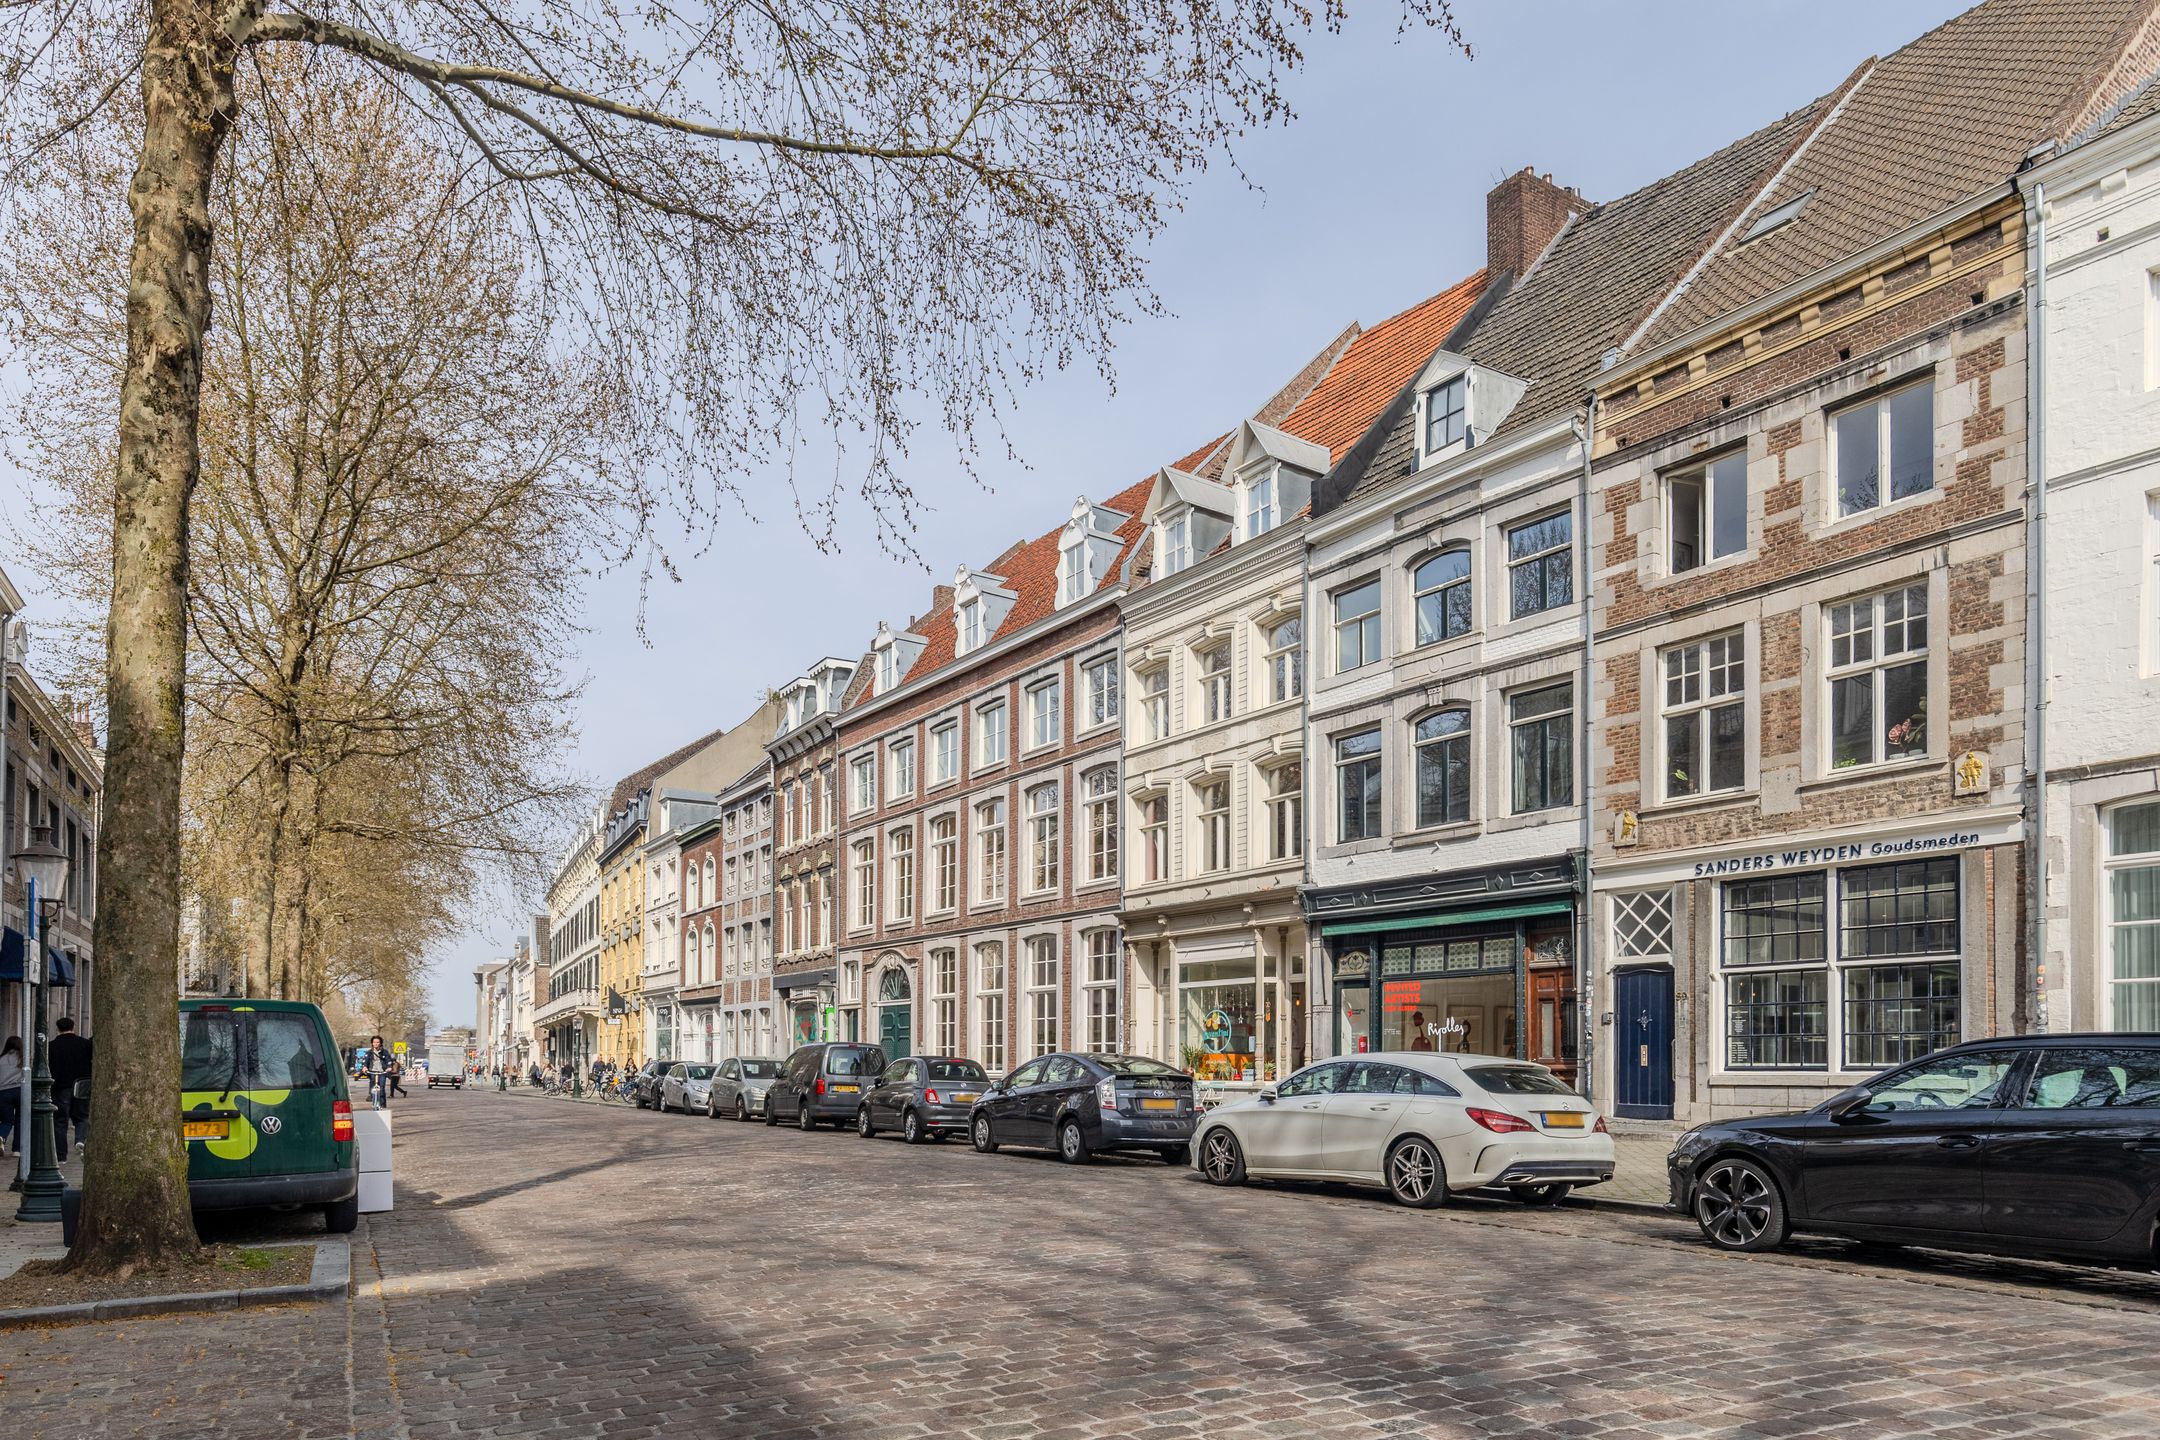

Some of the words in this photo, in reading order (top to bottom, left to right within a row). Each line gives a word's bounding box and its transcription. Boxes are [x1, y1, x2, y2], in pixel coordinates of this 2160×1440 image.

[1695, 855, 1774, 876] SANDERS
[1783, 844, 1862, 865] WEYDEN
[1871, 833, 1980, 854] Goudsmeden
[1385, 982, 1421, 993] INVITED
[1385, 994, 1421, 1004] ARTISTS
